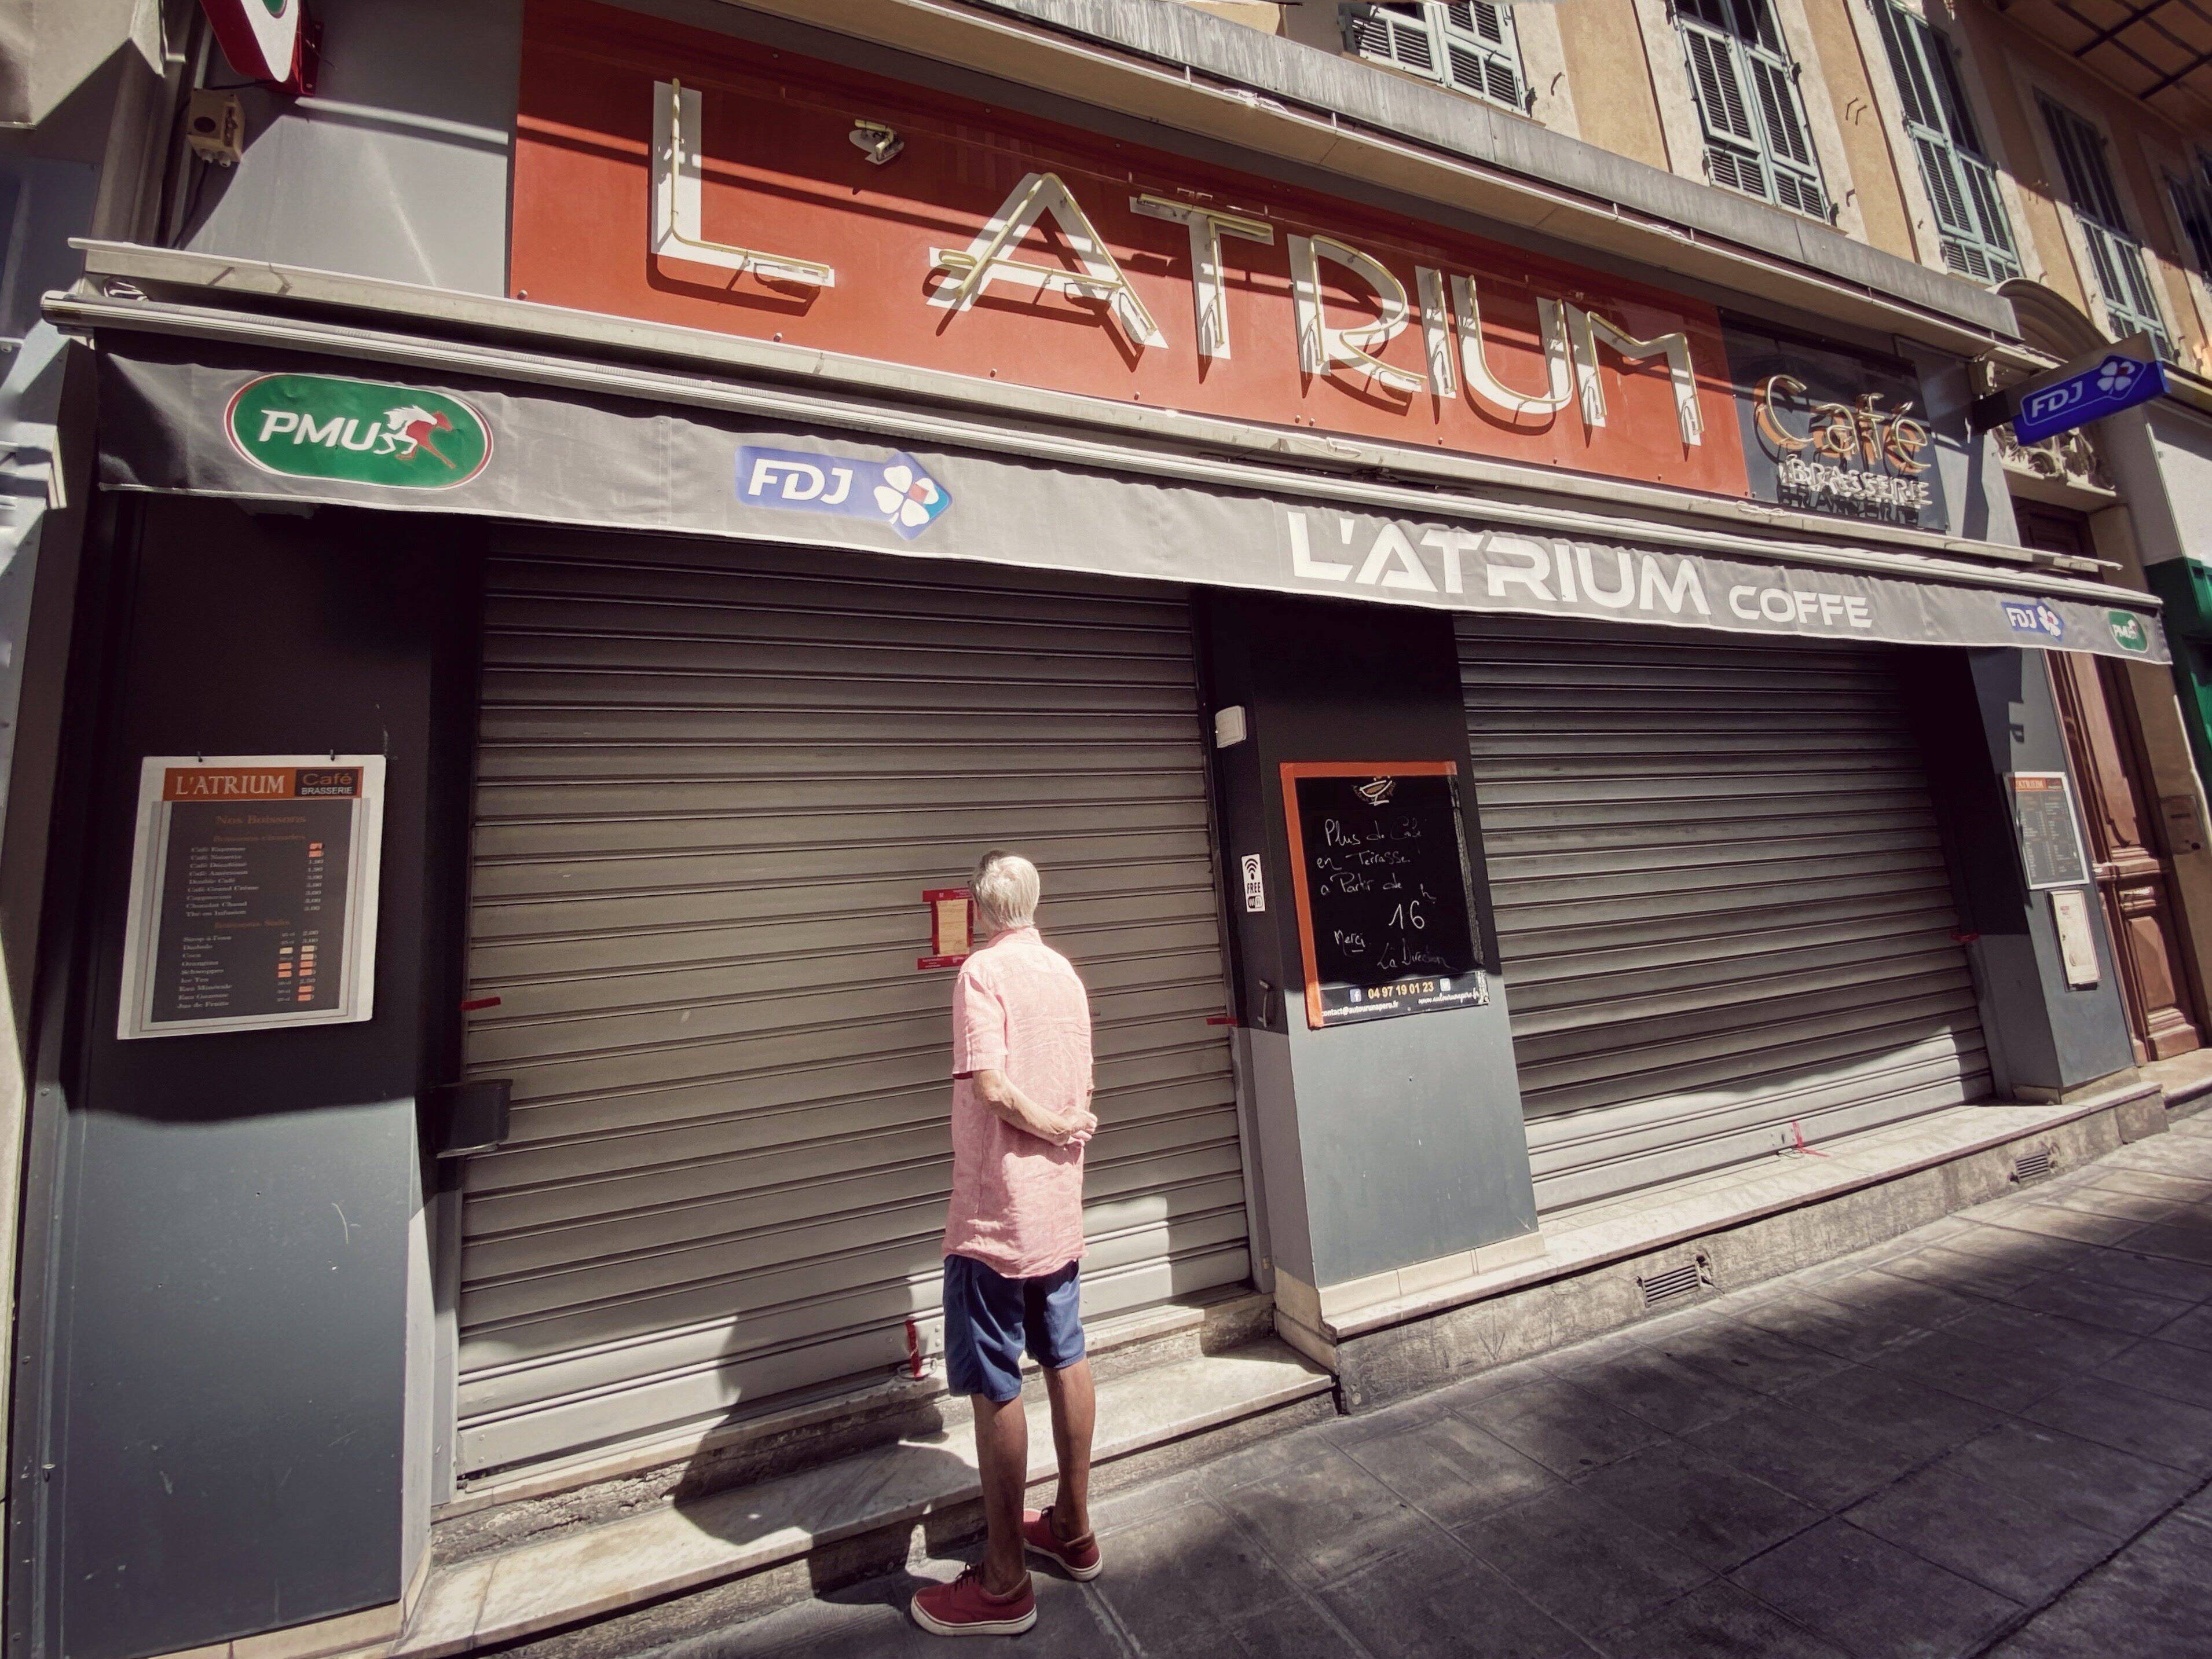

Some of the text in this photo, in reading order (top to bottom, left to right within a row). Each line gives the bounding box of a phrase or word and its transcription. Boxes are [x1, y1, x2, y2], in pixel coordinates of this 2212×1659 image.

[652, 79, 1702, 446] L'ATRIUM
[2031, 380, 2083, 418] FDJ
[258, 409, 382, 451] PMU
[1755, 373, 1932, 473] Café
[748, 458, 854, 504] FDJ
[1287, 511, 1873, 628] L'ATRIUM COFFE
[2005, 606, 2037, 629] FDJ
[175, 775, 285, 795] L'ATRIUM
[301, 786, 353, 795] BRASSERIE
[303, 772, 353, 786] Café
[1325, 818, 1361, 847] Plus
[1317, 857, 1343, 870] en
[1247, 882, 1261, 894] FREE
[1330, 871, 1375, 893] Partir
[1382, 872, 1403, 890] de
[1389, 900, 1425, 929] 16
[1377, 942, 1398, 970] La
[1368, 981, 1434, 1000] 04 97 19 01 23
